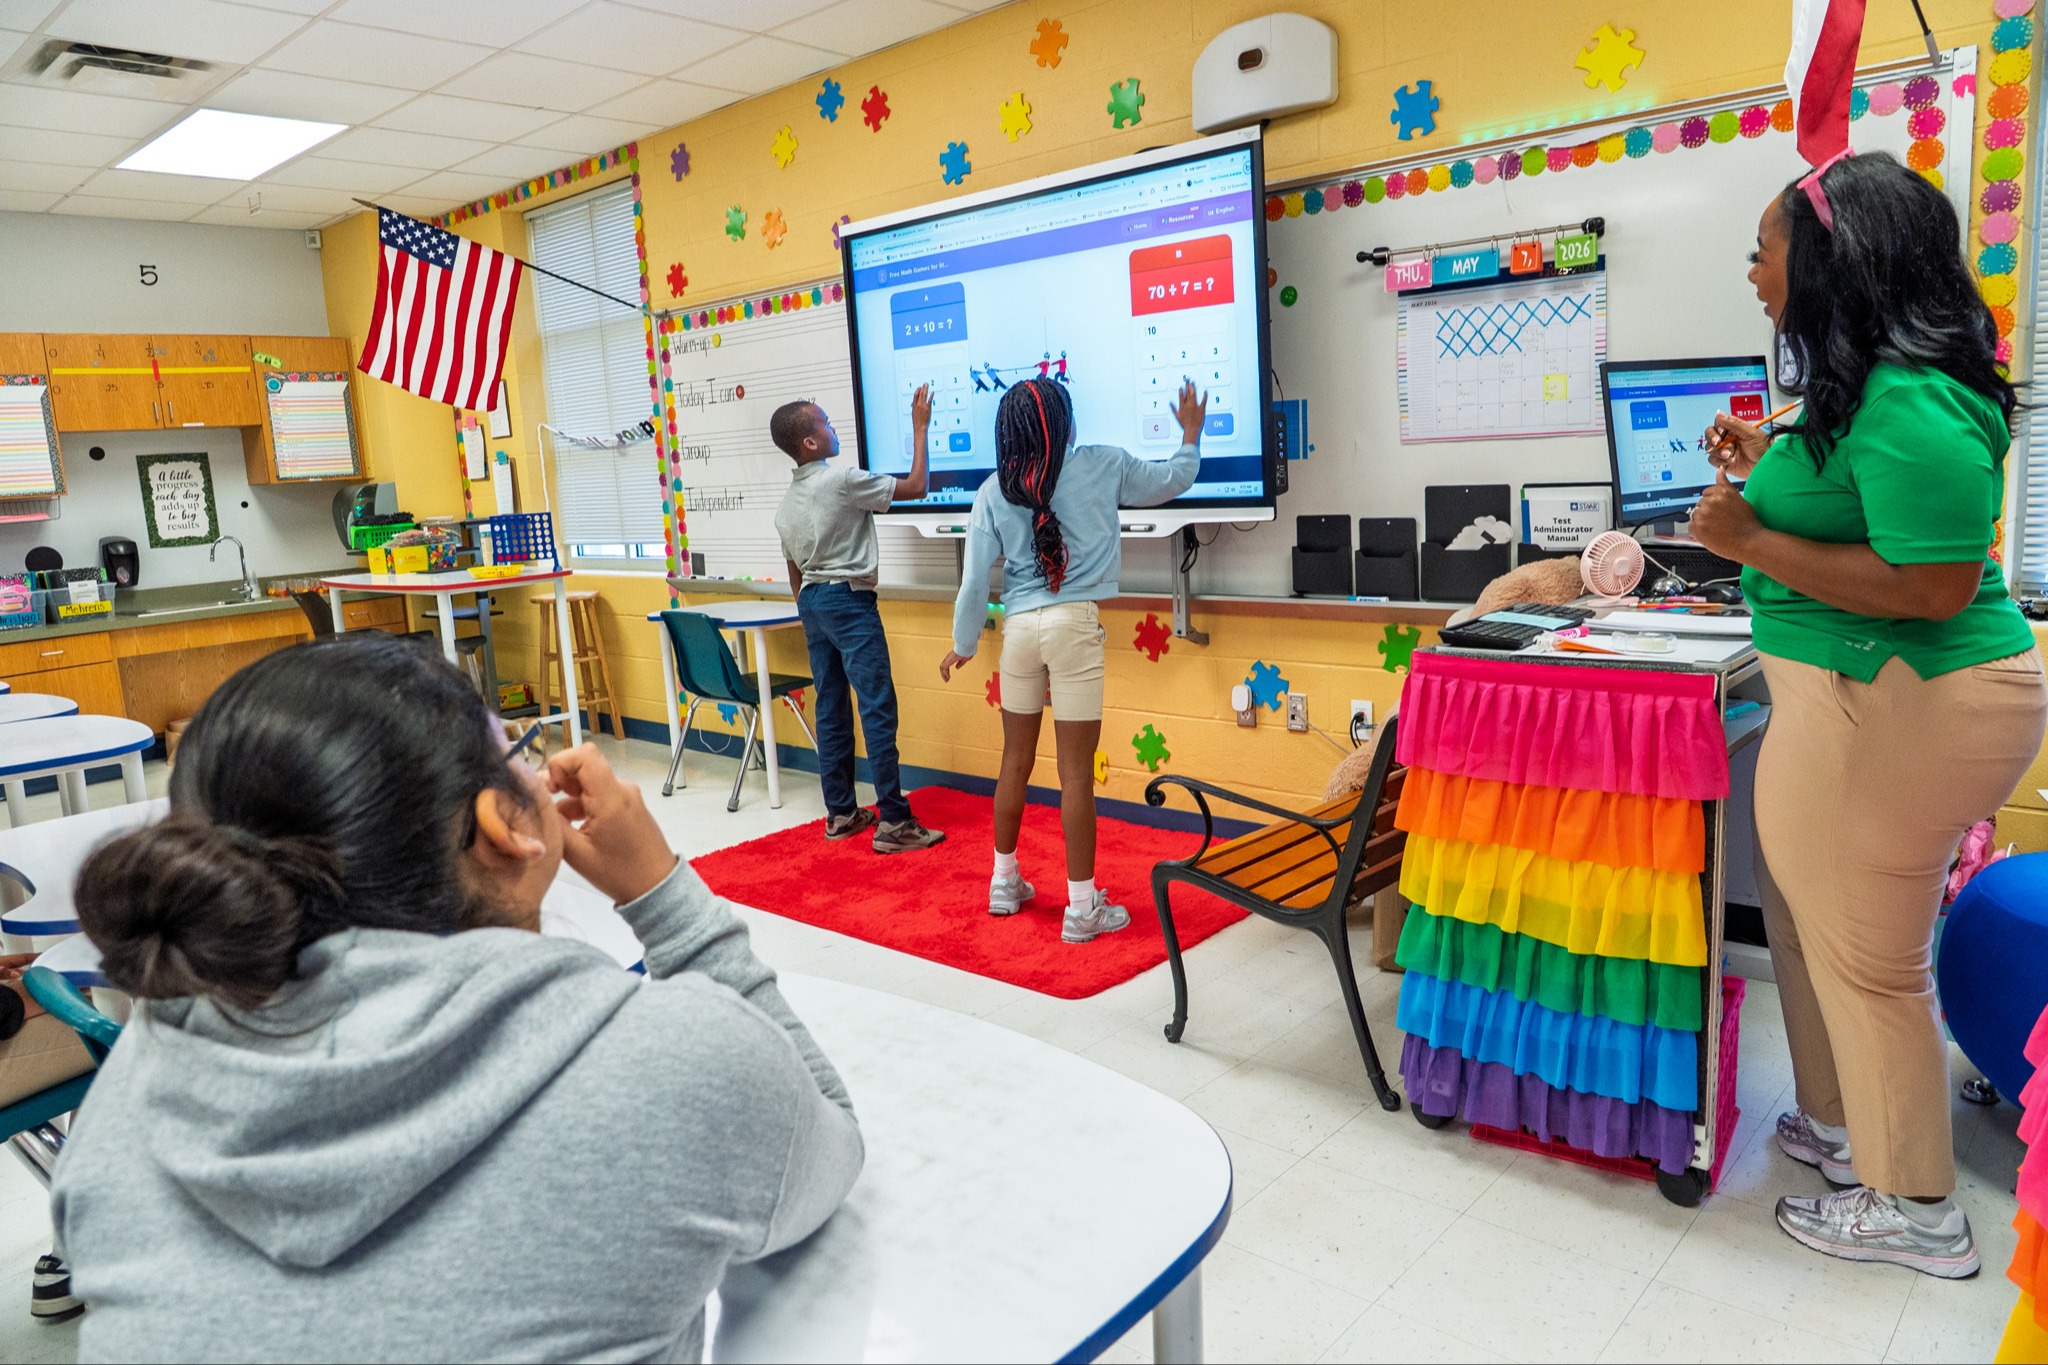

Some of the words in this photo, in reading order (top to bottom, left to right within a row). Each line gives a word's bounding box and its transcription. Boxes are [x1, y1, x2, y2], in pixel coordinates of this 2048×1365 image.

[1216, 206, 1235, 215] English
[1168, 214, 1194, 224] Resources
[1560, 241, 1590, 261] 2026
[900, 268, 912, 276] Math
[914, 266, 930, 274] Games
[1451, 256, 1479, 276] MAY
[140, 264, 158, 286] 5
[1394, 266, 1424, 285] THU.
[1148, 285, 1165, 300] 70
[1181, 281, 1189, 294] 7
[1206, 277, 1214, 291] ?
[906, 325, 912, 336] 2
[923, 320, 935, 333] 10
[946, 318, 953, 330] ?
[1148, 326, 1156, 336] 10
[672, 335, 710, 358] Warm-up
[674, 382, 704, 414] Today
[706, 378, 717, 405] I
[720, 388, 735, 402] can
[1154, 424, 1159, 432] C
[682, 435, 710, 466] Group
[158, 470, 166, 482] A
[169, 469, 194, 480] little
[156, 481, 199, 492] progress
[156, 491, 177, 501] each
[182, 490, 201, 502] day
[161, 501, 184, 511] adds
[187, 502, 200, 511] up
[168, 512, 177, 521] to
[181, 509, 197, 522] big
[167, 521, 200, 531] results
[1547, 534, 1579, 542] Manual
[65, 602, 106, 615] Mehrens
